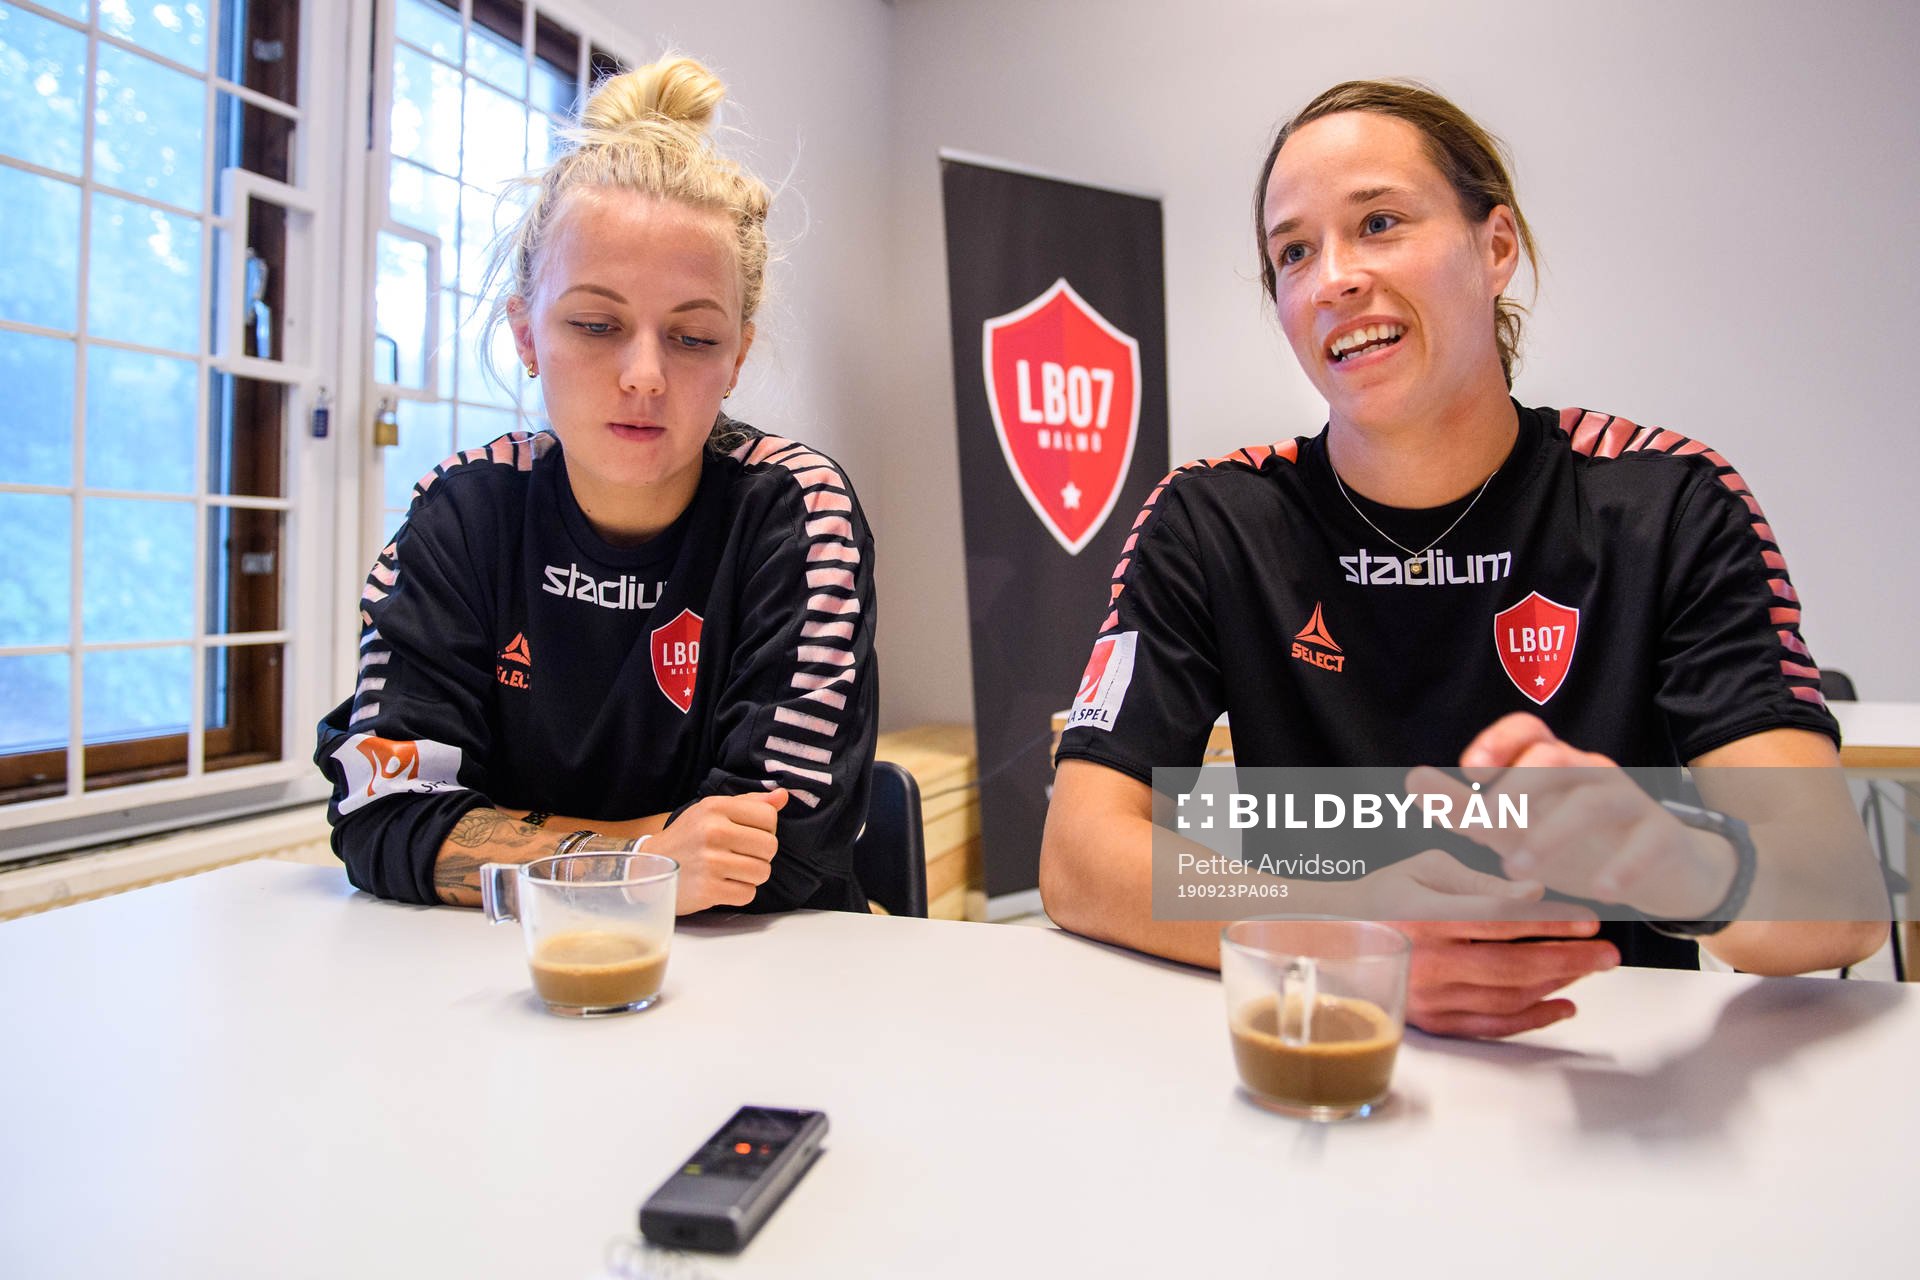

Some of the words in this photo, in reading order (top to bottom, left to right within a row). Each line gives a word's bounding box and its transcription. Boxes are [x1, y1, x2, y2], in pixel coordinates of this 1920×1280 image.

[1016, 359, 1115, 429] LB07
[1339, 549, 1511, 585] stadium
[542, 563, 667, 610] stadiu
[1508, 625, 1565, 653] LB07
[663, 641, 700, 667] LB0
[1291, 642, 1345, 673] SELECT
[671, 667, 697, 675] MALM
[1077, 708, 1109, 723] SPEL
